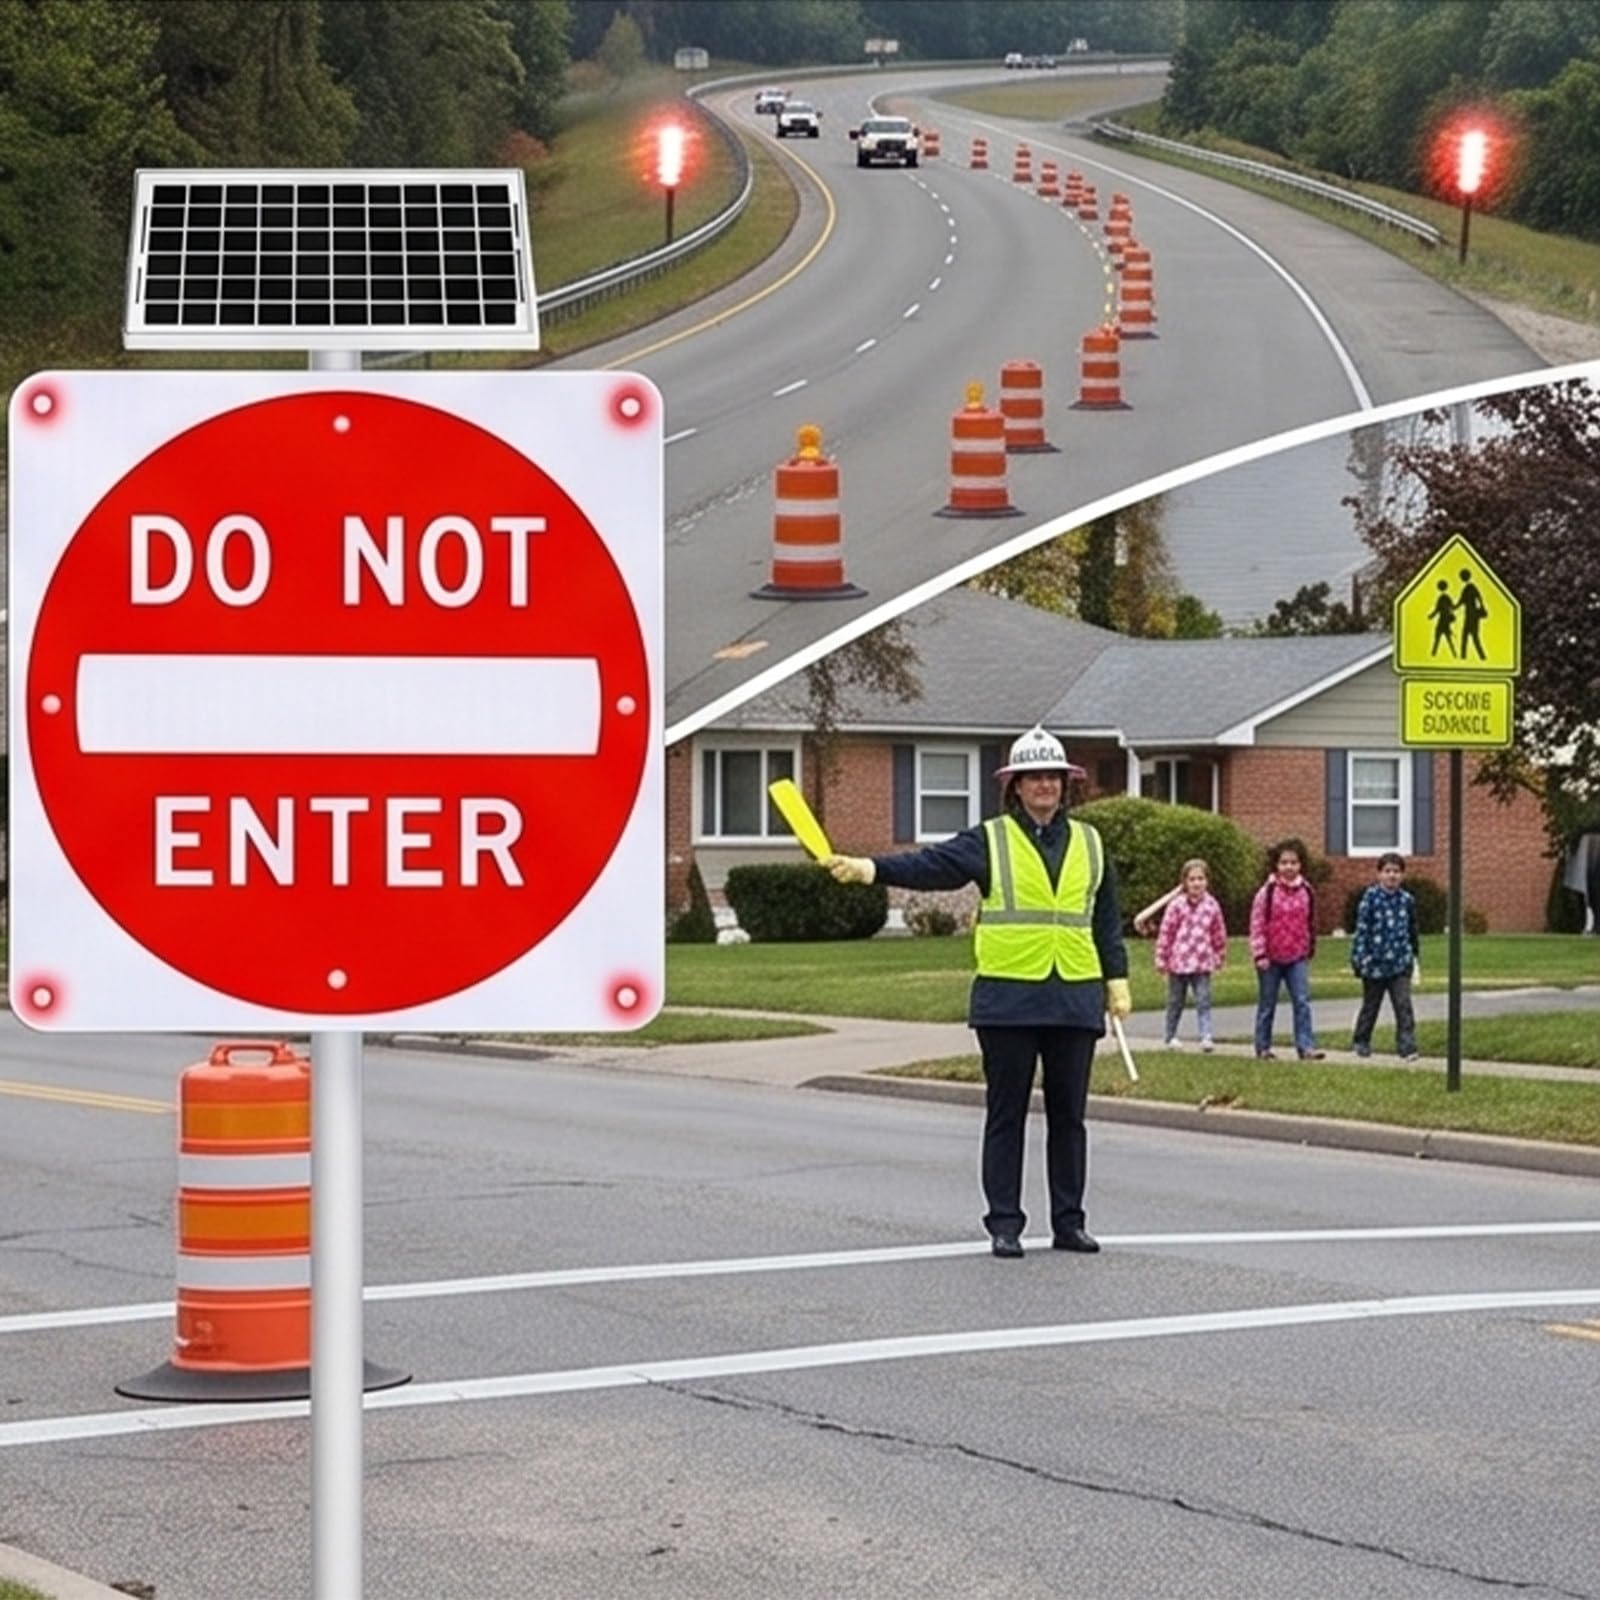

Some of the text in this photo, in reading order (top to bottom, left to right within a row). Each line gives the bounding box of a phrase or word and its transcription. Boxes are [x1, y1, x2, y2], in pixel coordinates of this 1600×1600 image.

[131, 515, 547, 607] DO NOT
[155, 796, 525, 888] ENTER
